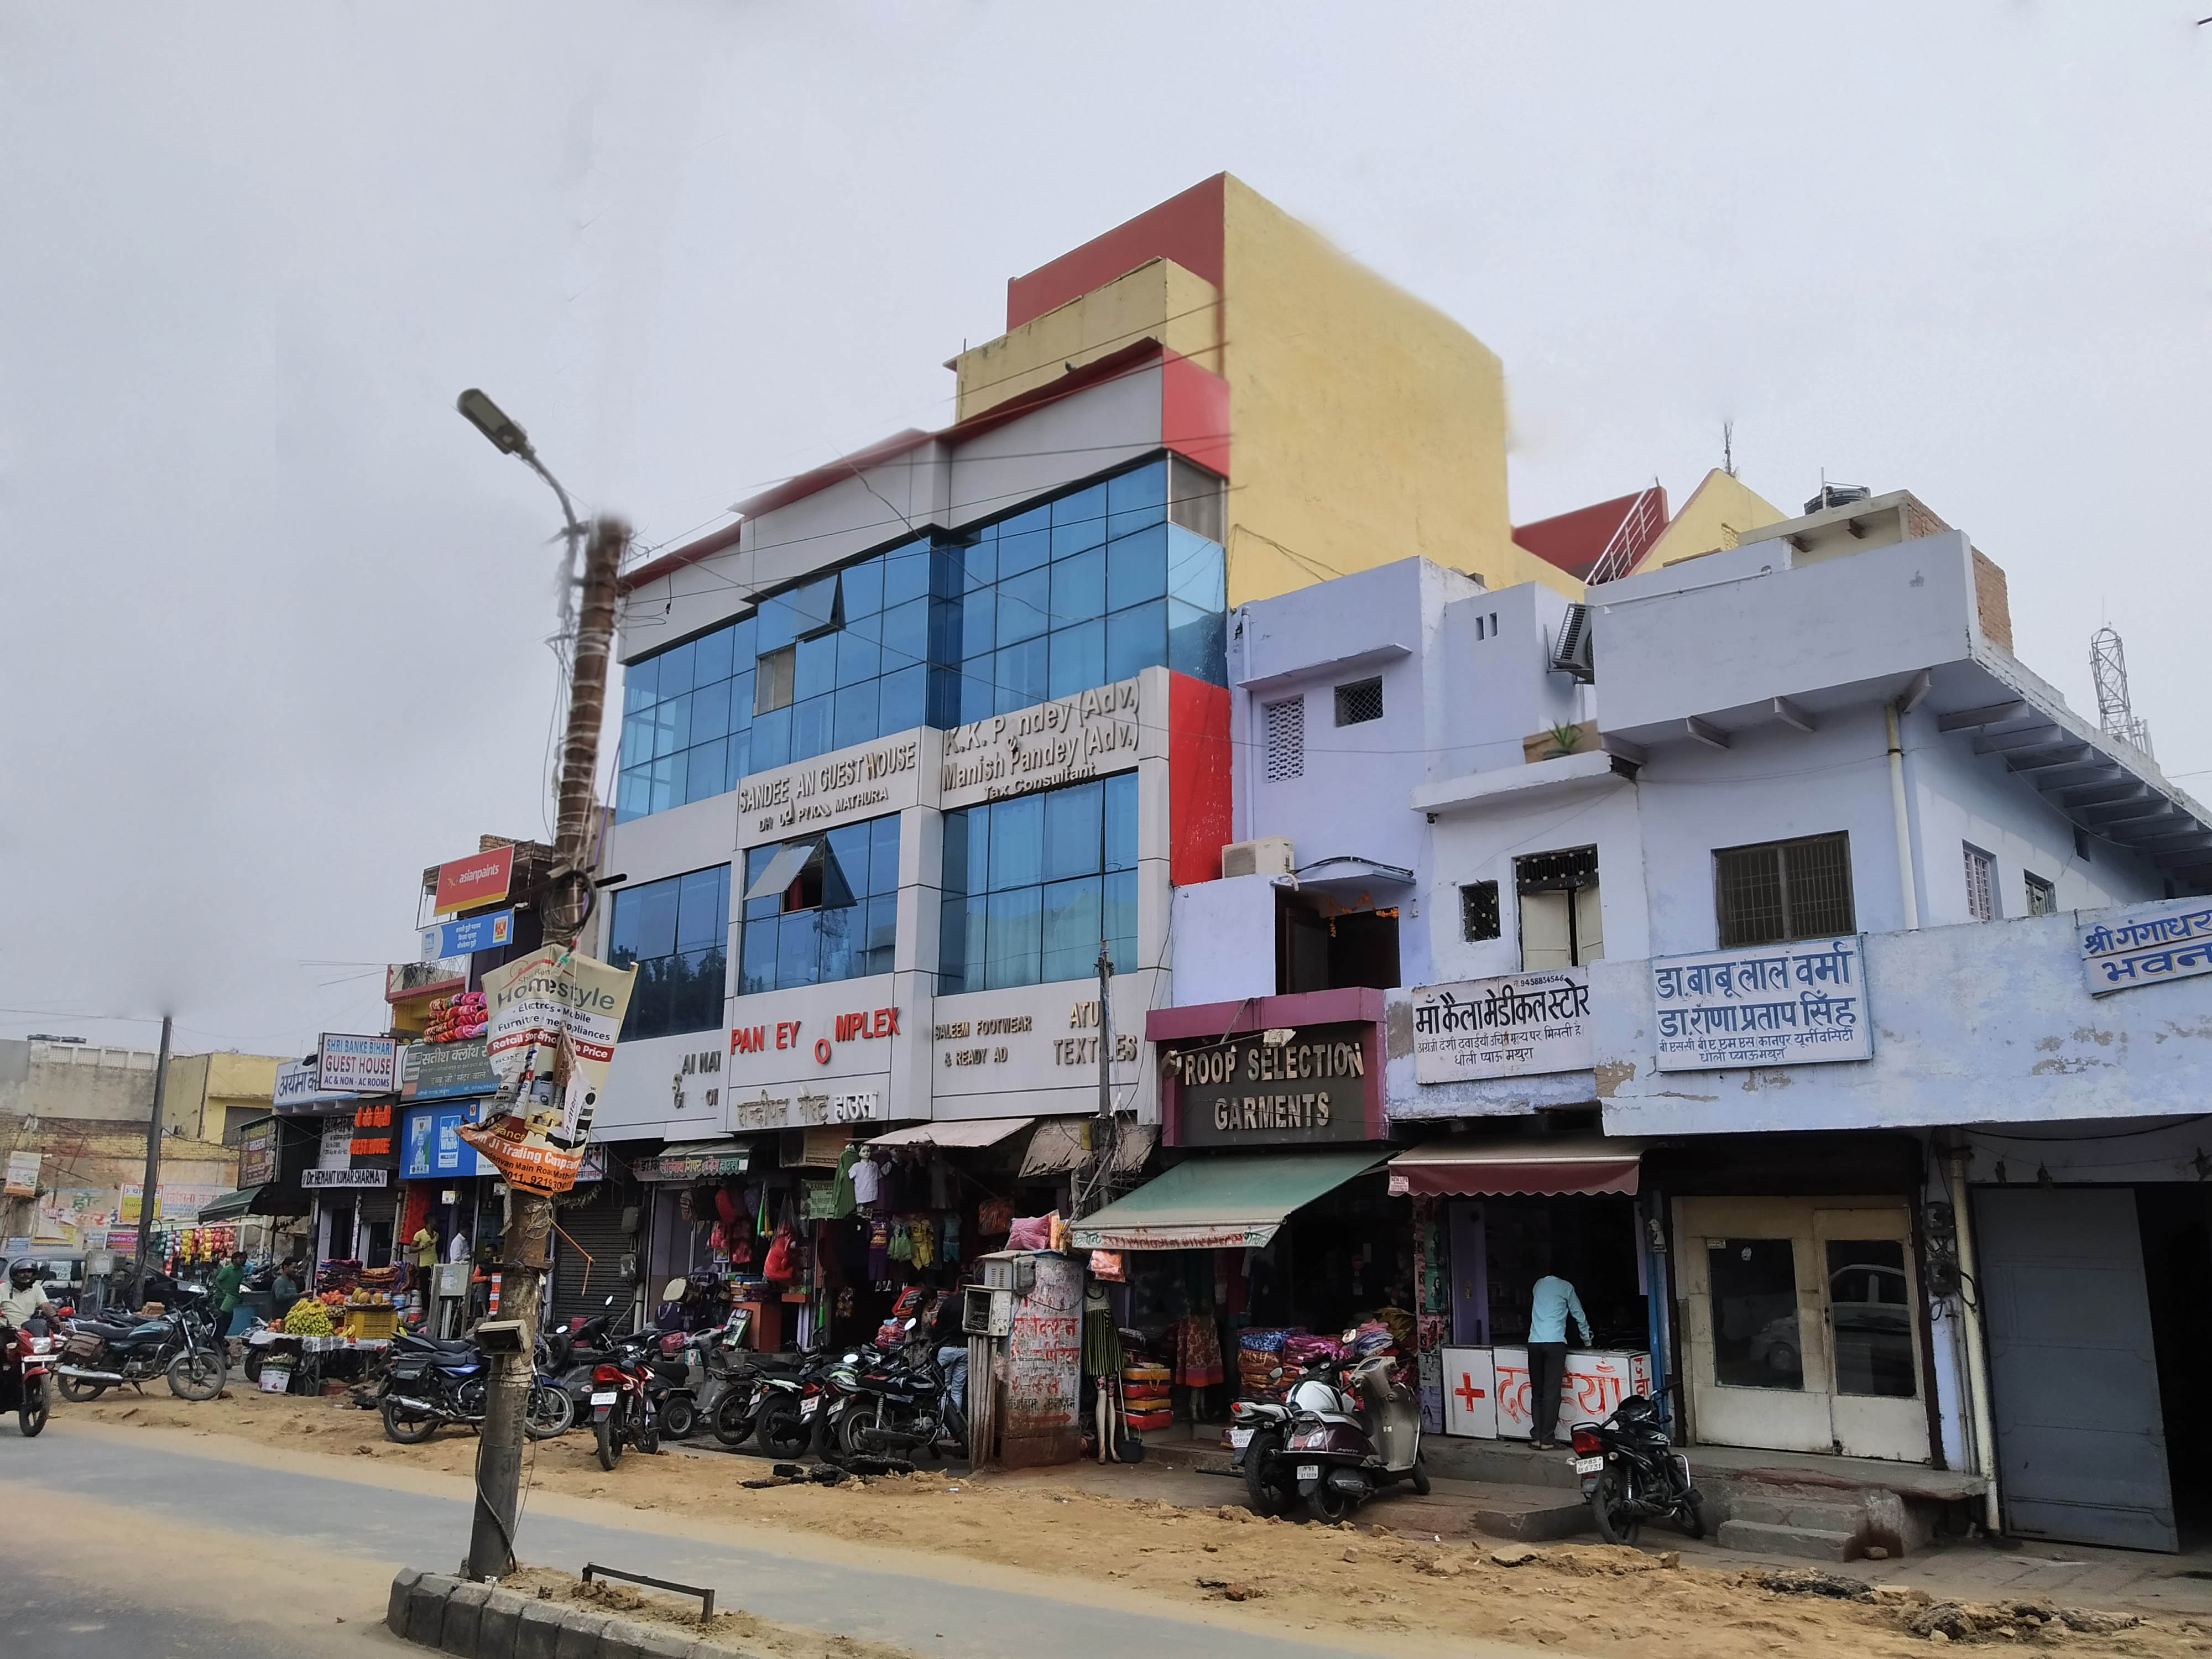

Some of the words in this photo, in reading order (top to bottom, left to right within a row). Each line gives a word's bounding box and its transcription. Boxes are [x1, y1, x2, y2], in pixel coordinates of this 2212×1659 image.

[993, 703, 1073, 744] Pndey
[1079, 676, 1140, 727] (Adv.)
[943, 752, 1005, 792] Manish
[1011, 737, 1079, 775] Pandey
[1084, 713, 1140, 764] (Adv.)
[820, 757, 864, 791] GUEST
[865, 742, 916, 780] HOUSE
[985, 785, 1010, 800] Tax
[1014, 763, 1097, 794] Consultant
[836, 787, 889, 812] MATHURA
[2084, 926, 2114, 954] श्री
[1738, 957, 1789, 992] लाल
[1792, 941, 1854, 985] वर्मा
[2102, 942, 2212, 982] भवन
[1070, 1000, 1100, 1029] ATU
[1416, 993, 1439, 1034] माँ
[1440, 992, 1483, 1032] कैला
[1484, 984, 1547, 1027] मेडीकल
[1548, 977, 1590, 1020] स्टोर
[1691, 1005, 1738, 1035] राणा
[1739, 1001, 1797, 1032] प्रताप
[1800, 990, 1857, 1027] सिंह
[565, 1022, 611, 1041] ppliances
[935, 1021, 970, 1040] SALEEM
[977, 1015, 1032, 1036] FOOTWEAR
[1530, 1030, 1542, 1041] पर
[1544, 1022, 1573, 1040] मिलती
[327, 1039, 342, 1052] SHRI
[345, 1040, 368, 1054] BANKE
[369, 1041, 393, 1055] BIHARI
[422, 1047, 451, 1065] सतीश
[452, 1043, 480, 1061] क्लॉथ
[493, 1033, 523, 1050] Retail
[582, 1044, 608, 1058] Price
[1480, 1050, 1503, 1063] प्याऊ
[1505, 1047, 1533, 1062] मथुरा
[326, 1055, 356, 1073] GUEST
[359, 1056, 391, 1075] HOUSE
[1185, 1051, 1236, 1086] ROOP
[1248, 1041, 1365, 1082] SELECTION
[324, 1076, 332, 1084] AC
[340, 1076, 354, 1086] NON
[358, 1078, 367, 1087] AC
[367, 1078, 390, 1087] ROOMS
[833, 1091, 879, 1124] हाउस
[1214, 1092, 1331, 1131] GARMENTS
[500, 1142, 542, 1164] Trading
[315, 1170, 337, 1185] HEMANT
[337, 1170, 354, 1184] KUMAR
[354, 1169, 380, 1184] SHARMA
[515, 1163, 534, 1173] Main
